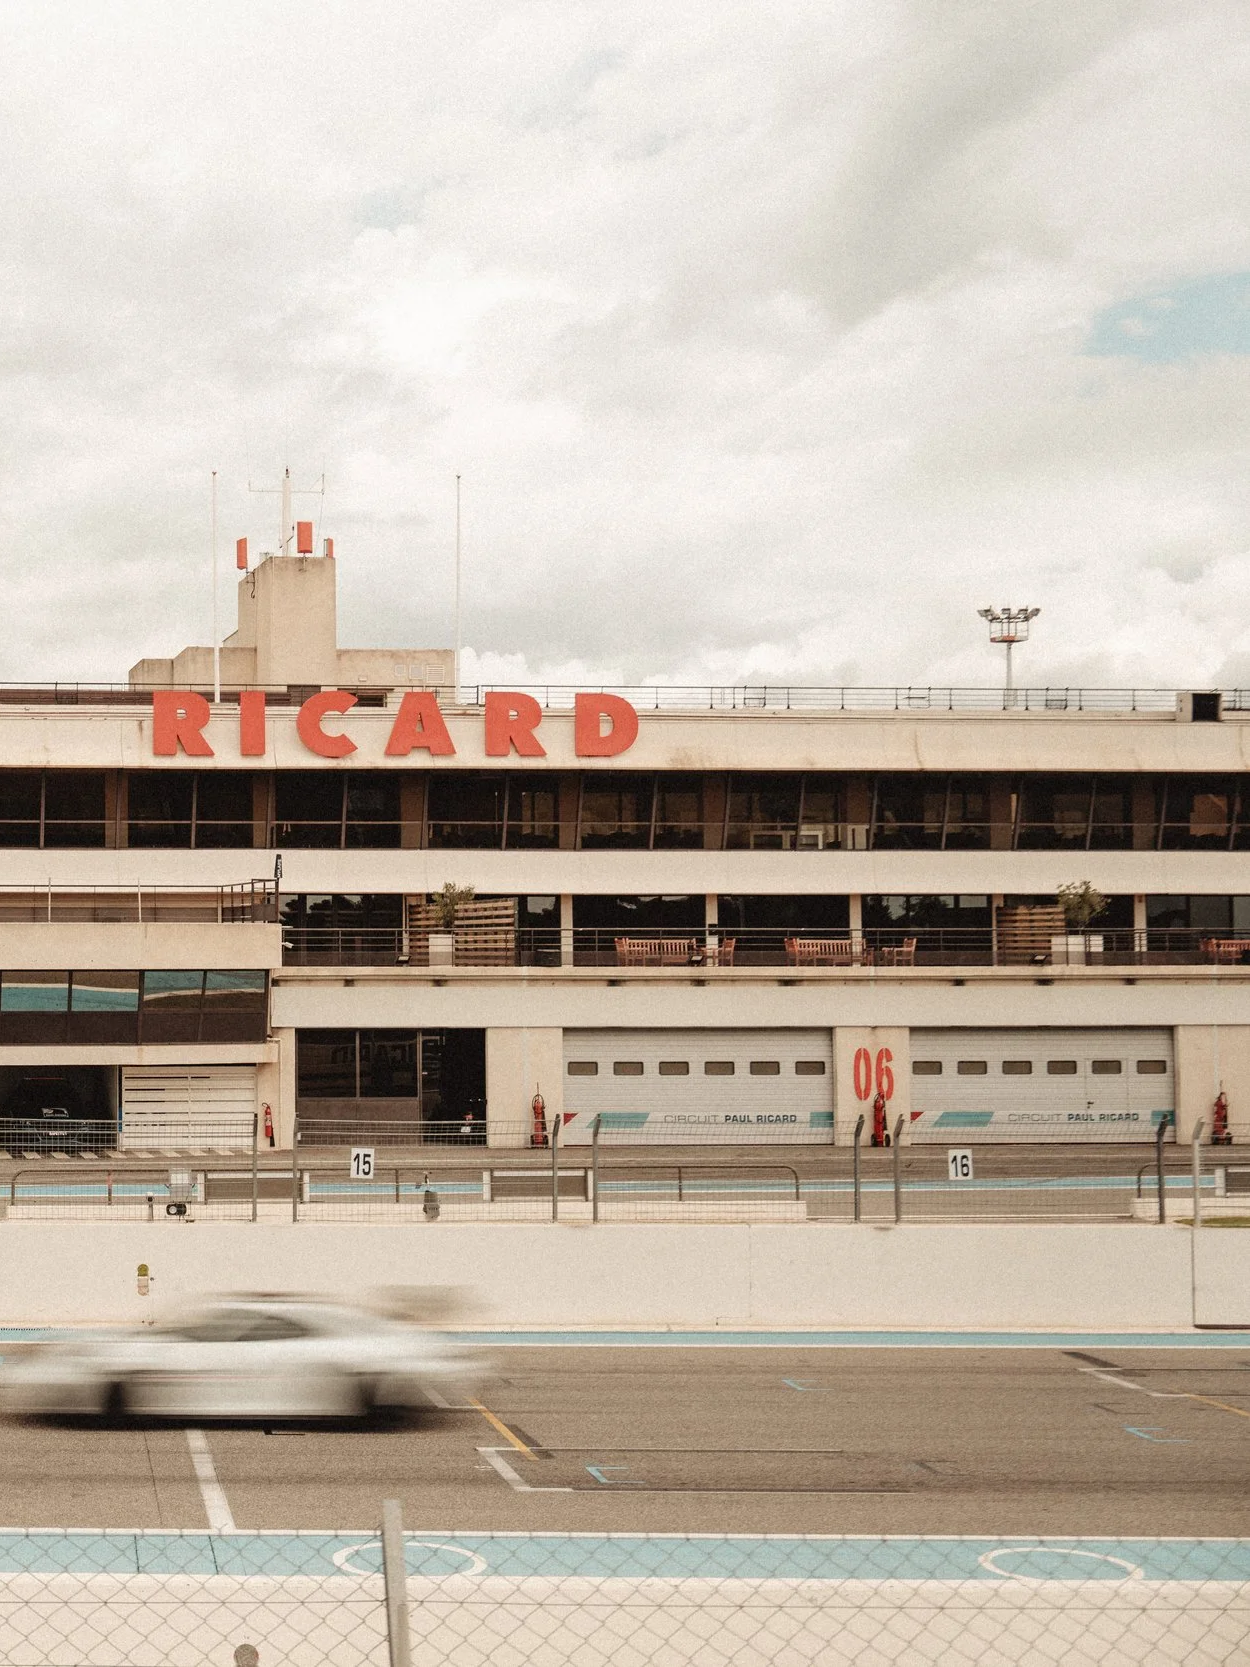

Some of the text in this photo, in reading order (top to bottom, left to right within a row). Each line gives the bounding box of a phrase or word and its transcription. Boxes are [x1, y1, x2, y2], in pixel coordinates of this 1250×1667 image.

[152, 690, 639, 758] RICARD
[853, 1047, 895, 1101] 06
[664, 1114, 797, 1124] CIRCUIT PAUL RICARD
[1008, 1113, 1139, 1122] CIRCUIT PAUL RICARD
[353, 1153, 371, 1176] 15
[951, 1154, 970, 1177] 16
